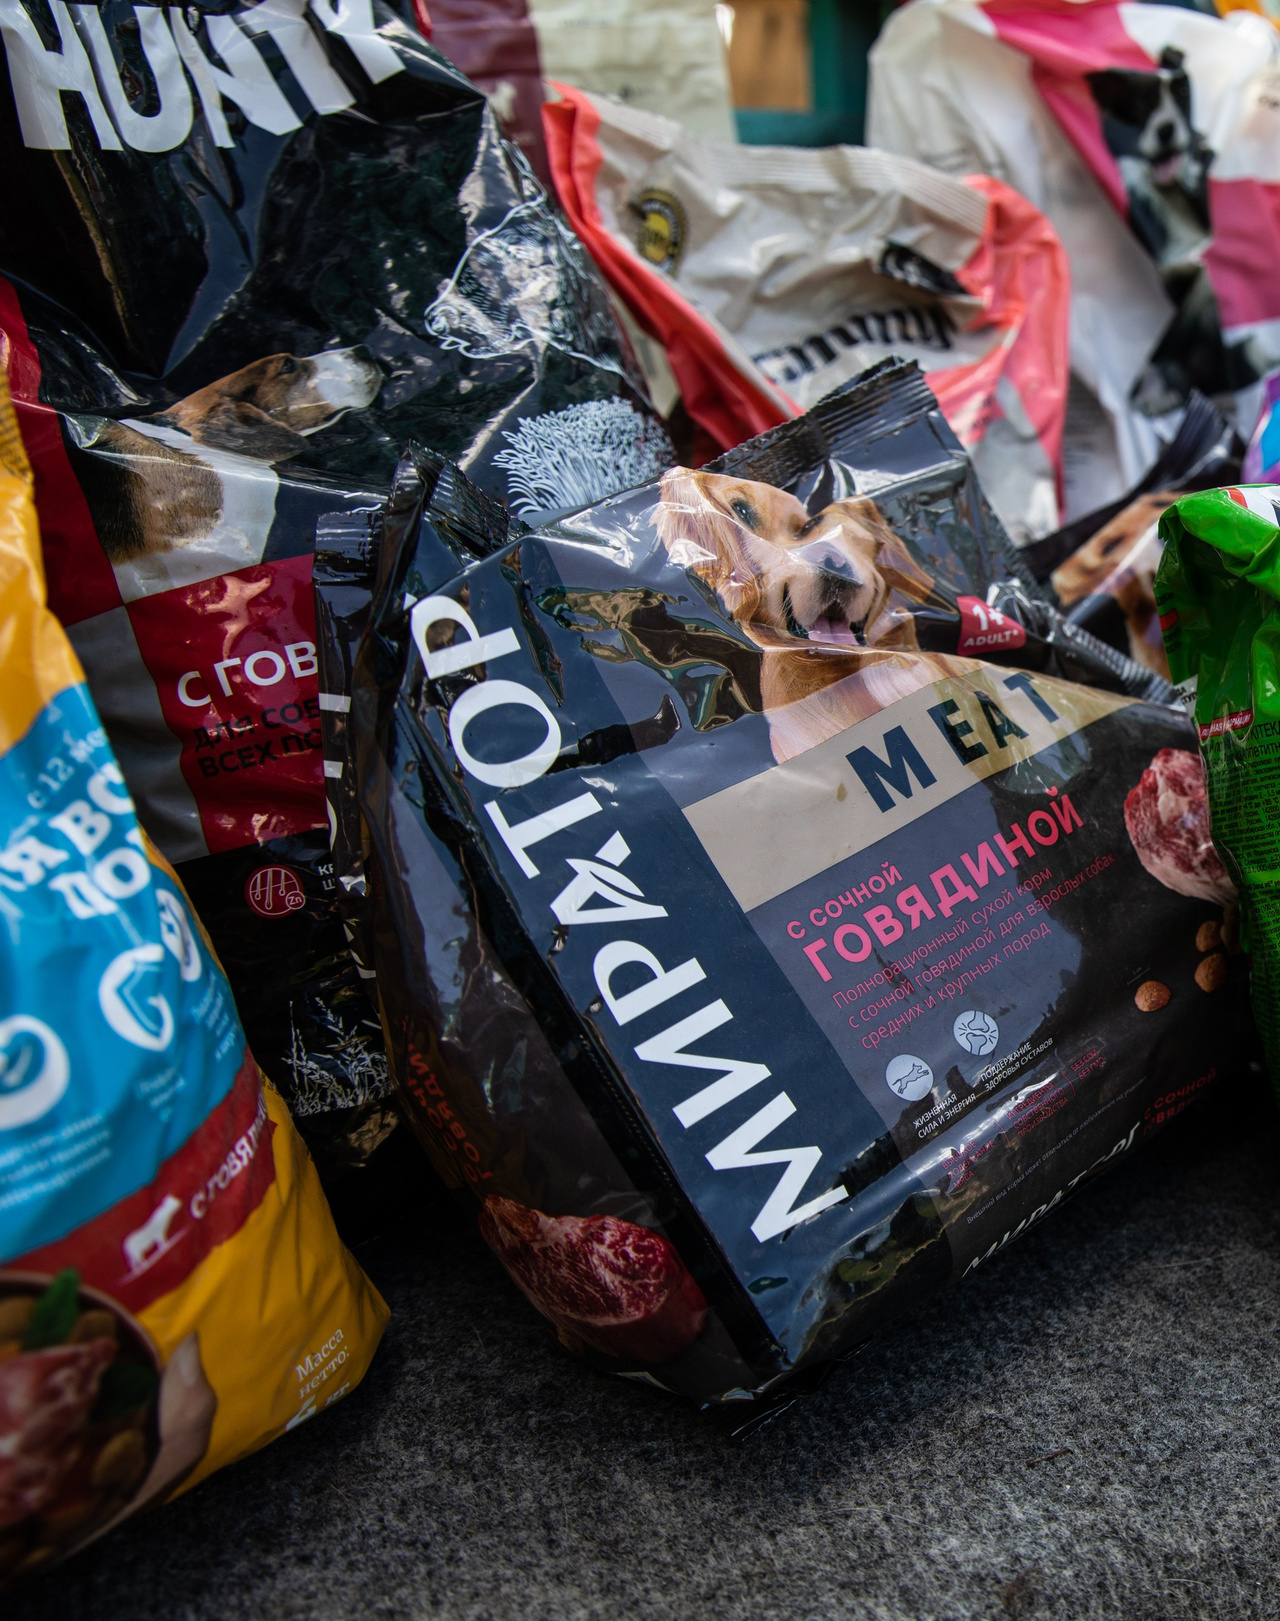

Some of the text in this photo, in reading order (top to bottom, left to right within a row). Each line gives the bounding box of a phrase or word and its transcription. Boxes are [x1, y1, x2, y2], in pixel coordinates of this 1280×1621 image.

[177, 640, 319, 708] С ГОВ
[197, 739, 279, 779] ВСЕХ
[844, 671, 1060, 815] MEAT
[802, 785, 1085, 984] ГОВЯДИНОЙ
[405, 593, 849, 1244] МИРАТОР
[831, 866, 1053, 1010] Полнорационный сухой корм
[859, 979, 916, 1023] сочной
[914, 927, 998, 988] говядиной
[998, 912, 1026, 939] для
[1026, 875, 1087, 918] взрослых
[1086, 851, 1117, 880] собак
[861, 1001, 926, 1050] средних
[936, 954, 1003, 1003] крупных
[1002, 921, 1053, 959] пород
[980, 1041, 1033, 1082] ПОДДЕРЖАНИЕ
[984, 1037, 1054, 1092] ЗДОРОВЬЯ СУСТАВОВ
[1069, 1057, 1085, 1072] БЕЗ
[1077, 1066, 1092, 1081] БЕЗ
[912, 1093, 958, 1130] ЖИЗНЕННАЯ
[917, 1092, 977, 1140] СИЛА И ЭНЕРГИЯ
[1006, 1082, 1055, 1121] ИНГРЕДИЕНТЫ
[1012, 1087, 1065, 1130] СОБСТВЕННОГО
[1017, 1098, 1069, 1139] ПРОИЗВОДСТВА
[941, 1140, 978, 1170] ВЫСОКОЕ
[952, 1170, 975, 1190] МЯСА
[966, 1199, 996, 1225] Внешний
[995, 1189, 1009, 1202] вид
[1007, 1174, 1027, 1192] корма
[1025, 1158, 1043, 1176] может
[1041, 1133, 1073, 1162] отличаться
[1072, 1127, 1081, 1137] от
[1079, 1101, 1117, 1132] изображения
[295, 1328, 345, 1383] Масса
[299, 1345, 350, 1400] нетто:
